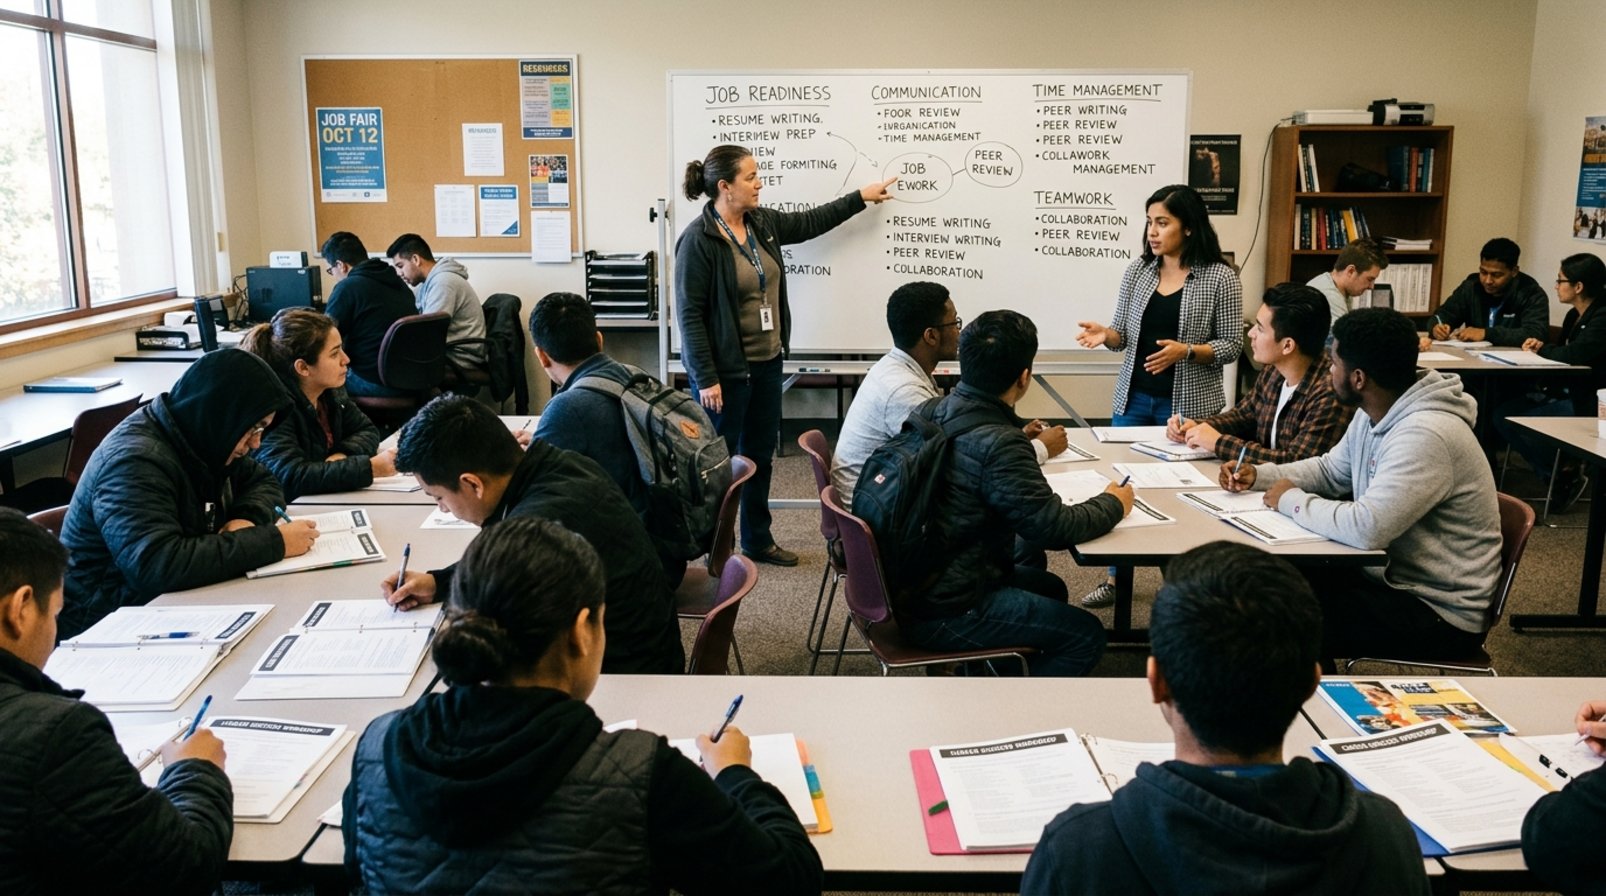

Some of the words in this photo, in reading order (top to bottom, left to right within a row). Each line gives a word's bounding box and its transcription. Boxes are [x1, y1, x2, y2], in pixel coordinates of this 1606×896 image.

[705, 85, 740, 104] JOB
[749, 85, 831, 101] READINESS
[871, 85, 982, 99] COMMUNICATION
[1032, 84, 1066, 97] TIME
[1073, 83, 1163, 96] MANAGEMENT
[919, 107, 961, 117] REVIEW
[1043, 105, 1072, 116] PEER
[1078, 104, 1128, 116] WRITING
[321, 113, 346, 126] JOB
[350, 112, 378, 126] FAIR
[718, 114, 765, 126] RESUME
[1043, 120, 1070, 130] PEER
[1075, 119, 1118, 130] REVIEW
[322, 127, 354, 144] OCT
[359, 127, 378, 144] 12
[787, 128, 817, 140] PREP
[884, 134, 908, 143] TIME
[913, 132, 981, 142] MANAGEMENT
[1043, 135, 1071, 145] PEER
[1078, 134, 1123, 144] REVIEW
[975, 150, 1003, 161] PEER
[1042, 150, 1110, 161] COLLAWORK
[780, 159, 837, 170] FORMITING
[900, 162, 926, 175] JOB
[972, 164, 1013, 176] REVIEW
[1073, 164, 1156, 175] MANAGEMENT
[897, 180, 938, 191] EWORK
[1033, 190, 1114, 206] TEAMWORK
[893, 215, 937, 227] RESUME
[942, 217, 991, 229] WRITING
[1041, 213, 1128, 226] COLLABORATION
[893, 232, 950, 244] INTERVIEW
[954, 235, 1002, 247] WRITING
[1042, 228, 1071, 239] PEER
[1076, 229, 1120, 241] REVIEW
[893, 247, 920, 258] PEER
[925, 248, 966, 260] REVIEW
[1041, 245, 1131, 260] COLLABORATION
[893, 263, 984, 280] COLLABORATION
